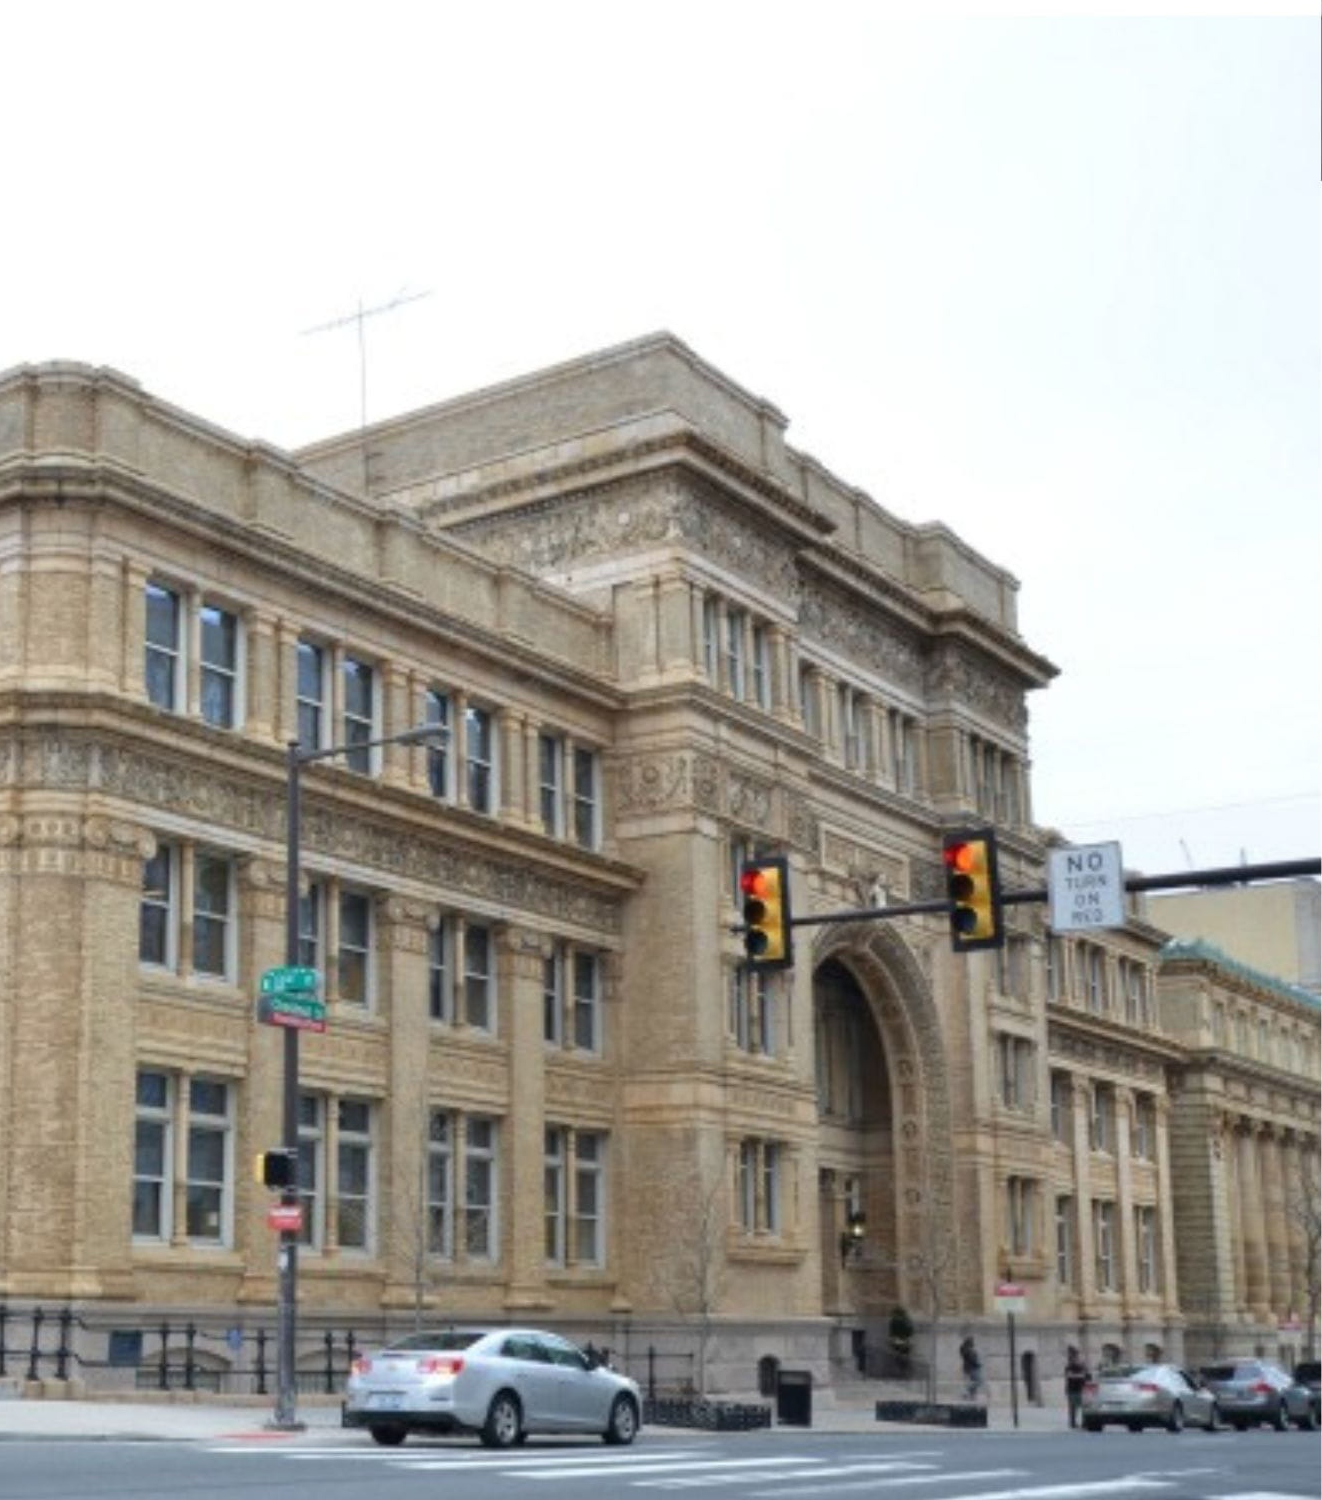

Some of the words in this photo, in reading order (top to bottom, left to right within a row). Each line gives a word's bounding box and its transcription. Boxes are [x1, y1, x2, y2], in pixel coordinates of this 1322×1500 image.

[1067, 851, 1103, 873] NO
[1064, 874, 1107, 890] TURN
[1074, 891, 1100, 908] ON
